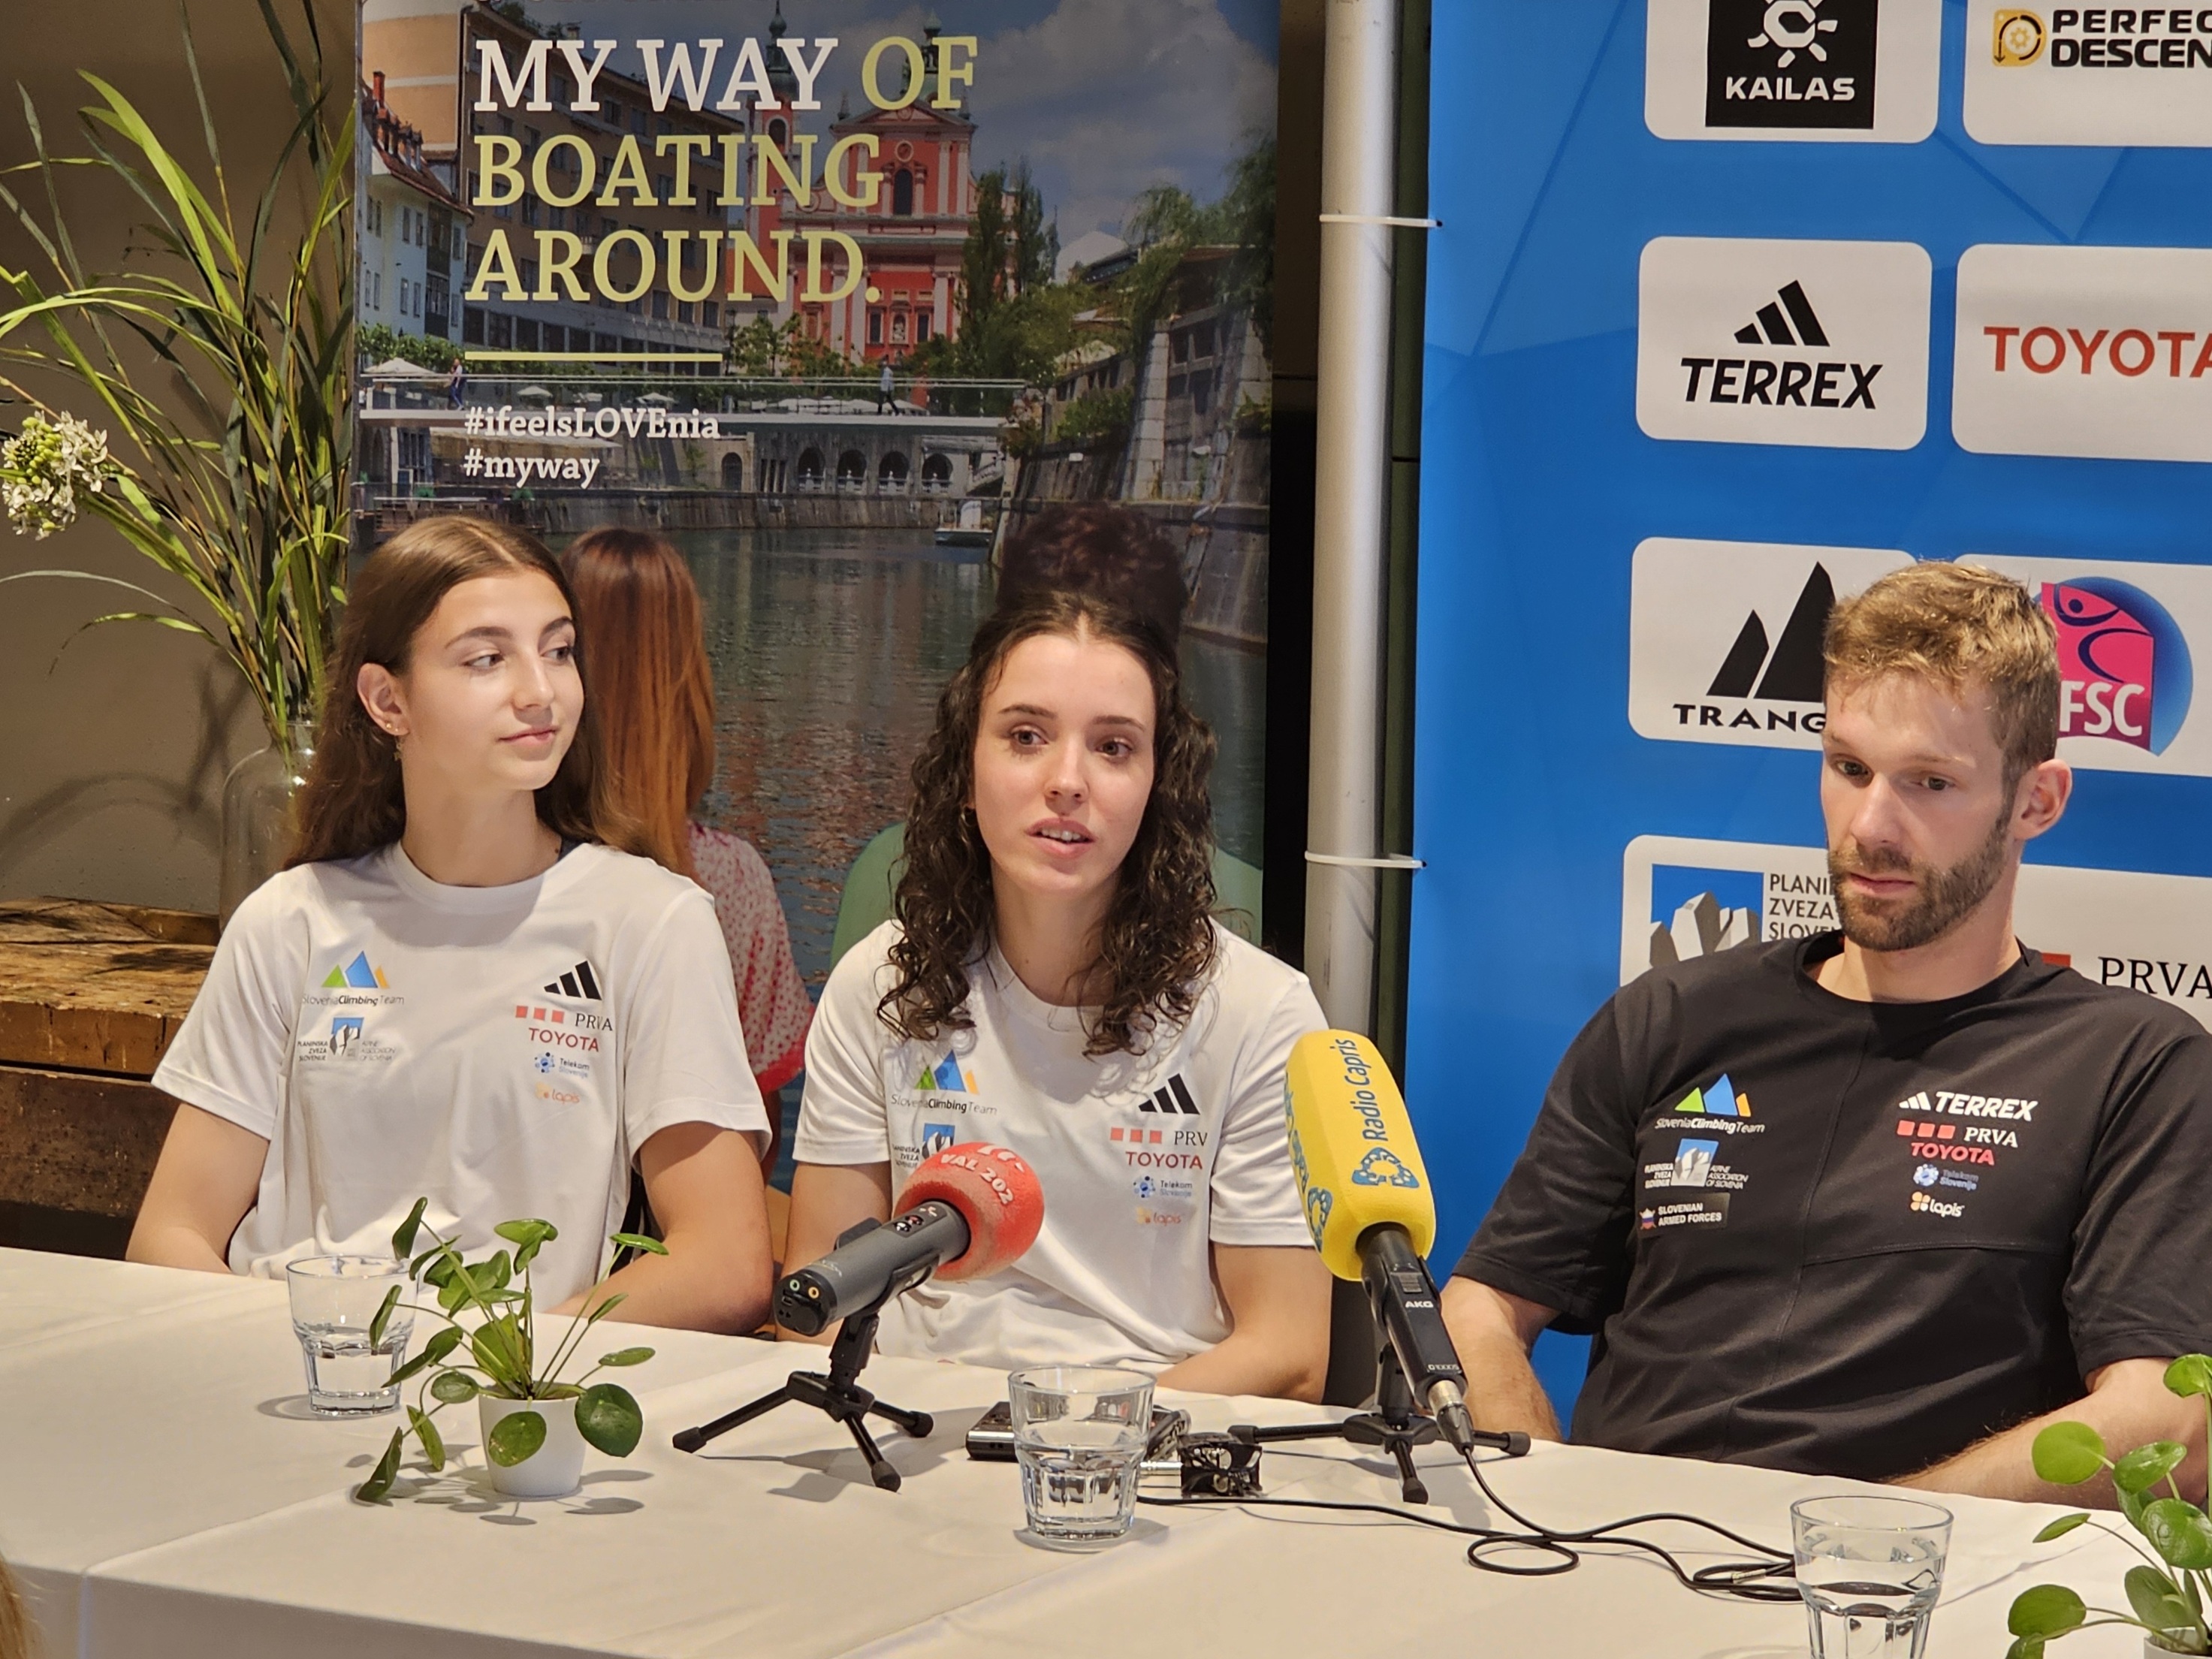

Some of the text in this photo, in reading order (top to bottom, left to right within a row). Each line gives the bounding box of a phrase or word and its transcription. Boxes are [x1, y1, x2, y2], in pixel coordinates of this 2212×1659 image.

[474, 36, 978, 112] MY WAY OF
[1726, 76, 1855, 101] KAILAS
[472, 133, 885, 209] BOATING
[464, 228, 881, 304] AROUND.
[1680, 357, 1883, 410] TERREX
[463, 405, 720, 440] #ifeelsLOVEnia
[463, 448, 600, 489] #myway
[1769, 897, 1834, 920] ZVEZA
[2098, 955, 2212, 1000] PRVA
[529, 1027, 599, 1052] TOYOTA
[560, 1057, 590, 1070] Telekom
[1329, 1038, 1388, 1142] Radio Capris
[1935, 1090, 2038, 1121] TERREX
[1963, 1126, 2018, 1148] PRVA
[1125, 1151, 1203, 1170] TOYOTA
[1911, 1142, 1995, 1166] TOYOTA
[940, 1154, 979, 1172] VAL
[979, 1166, 1014, 1205] 202
[1160, 1180, 1193, 1189] Telekom
[1658, 1202, 1703, 1215] SLOVENIAN
[1658, 1212, 1722, 1226] ARMED FORCES
[1930, 1199, 1963, 1217] lapis
[1405, 1300, 1434, 1308] AKG
